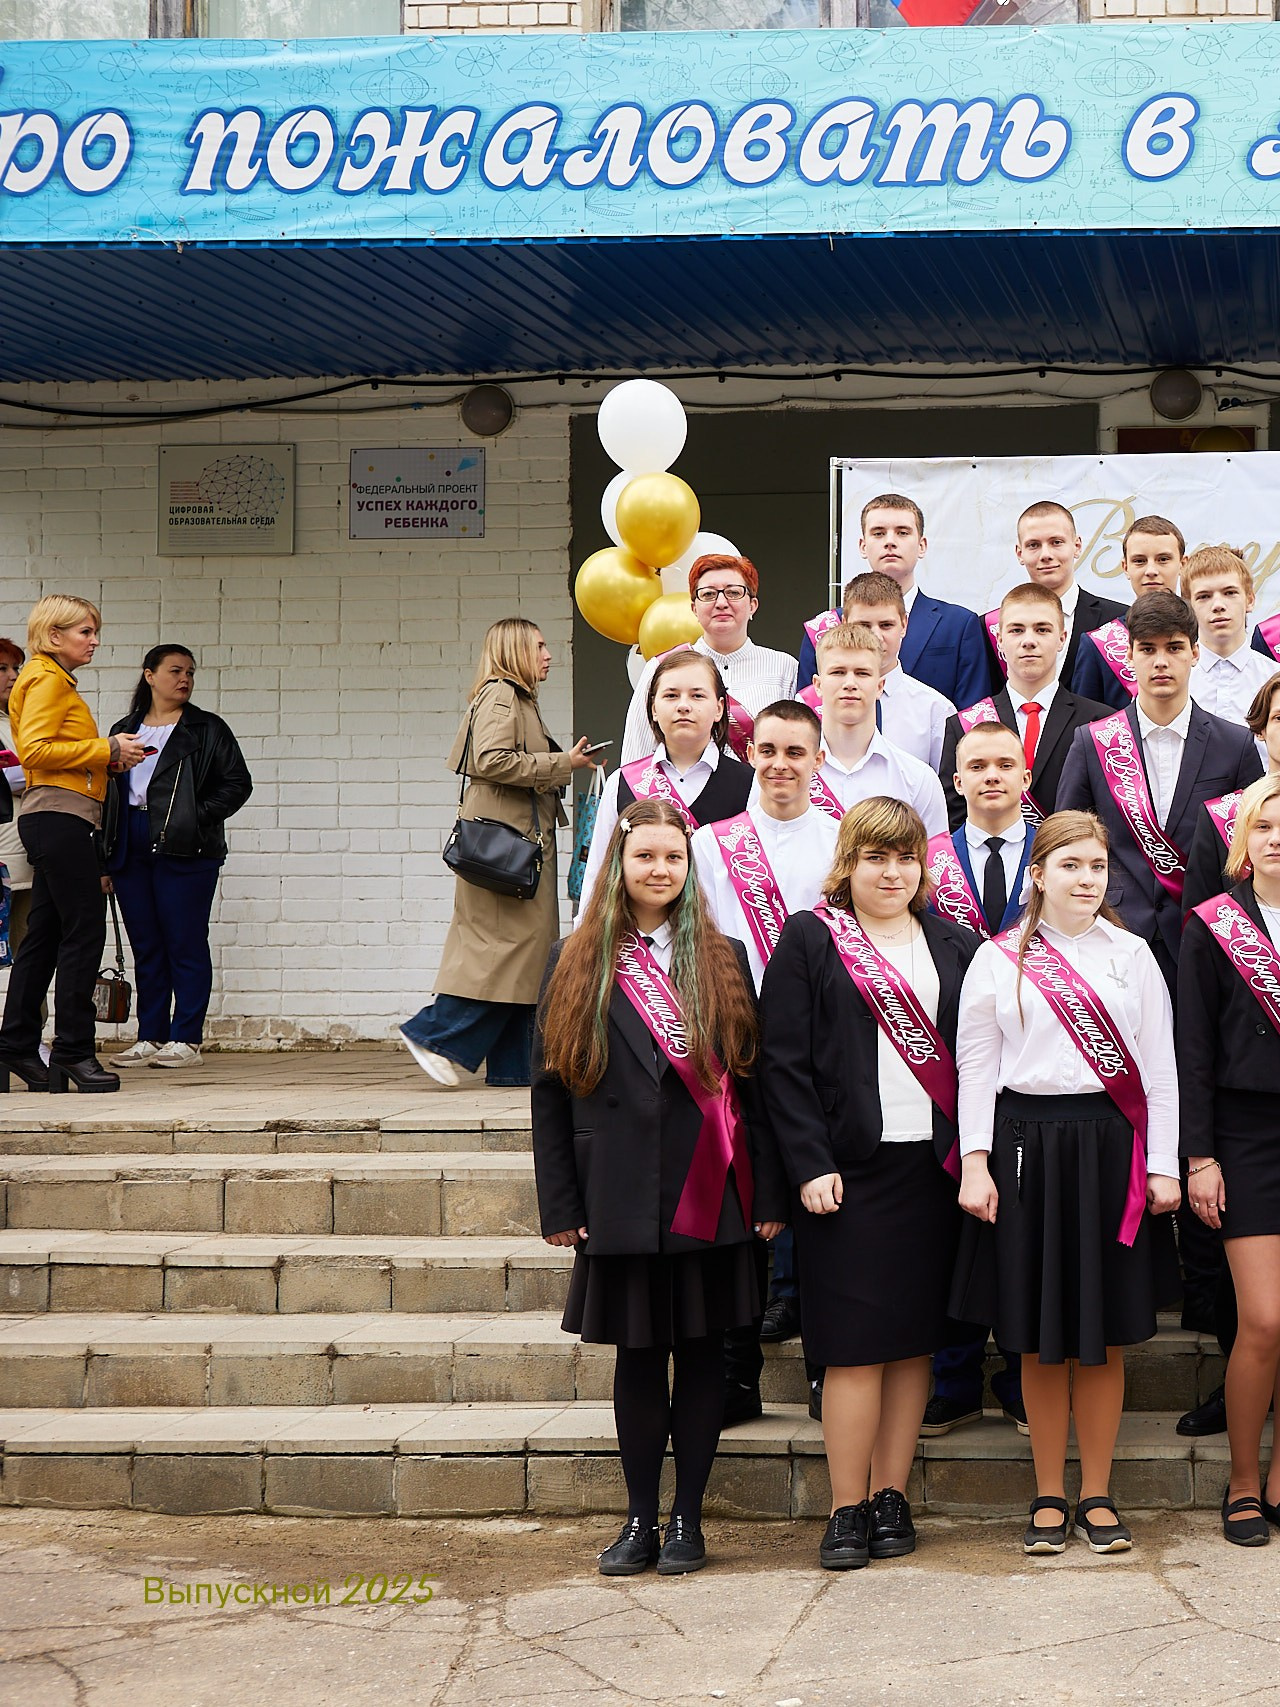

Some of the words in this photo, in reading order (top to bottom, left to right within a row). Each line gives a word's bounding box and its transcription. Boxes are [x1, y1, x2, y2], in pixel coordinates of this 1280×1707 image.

[0, 106, 135, 196] ро
[180, 93, 1072, 196] пожаловать
[1122, 91, 1200, 182] в
[356, 483, 435, 495] ФЕДЕРАЛЬНЫЙ
[437, 484, 479, 494] ПРОЕКТ
[169, 505, 214, 515] ЦИФРОВАЯ
[356, 499, 402, 512] УСПЕХ
[405, 498, 478, 512] КАЖДОГО
[168, 516, 248, 526] ОБРАЗОВАТЕЛЬНАЯ
[250, 516, 276, 527] СРЕДА
[384, 517, 449, 529] РЕБЕНКА
[901, 1026, 941, 1066] 2025
[1091, 1040, 1129, 1078] 2025
